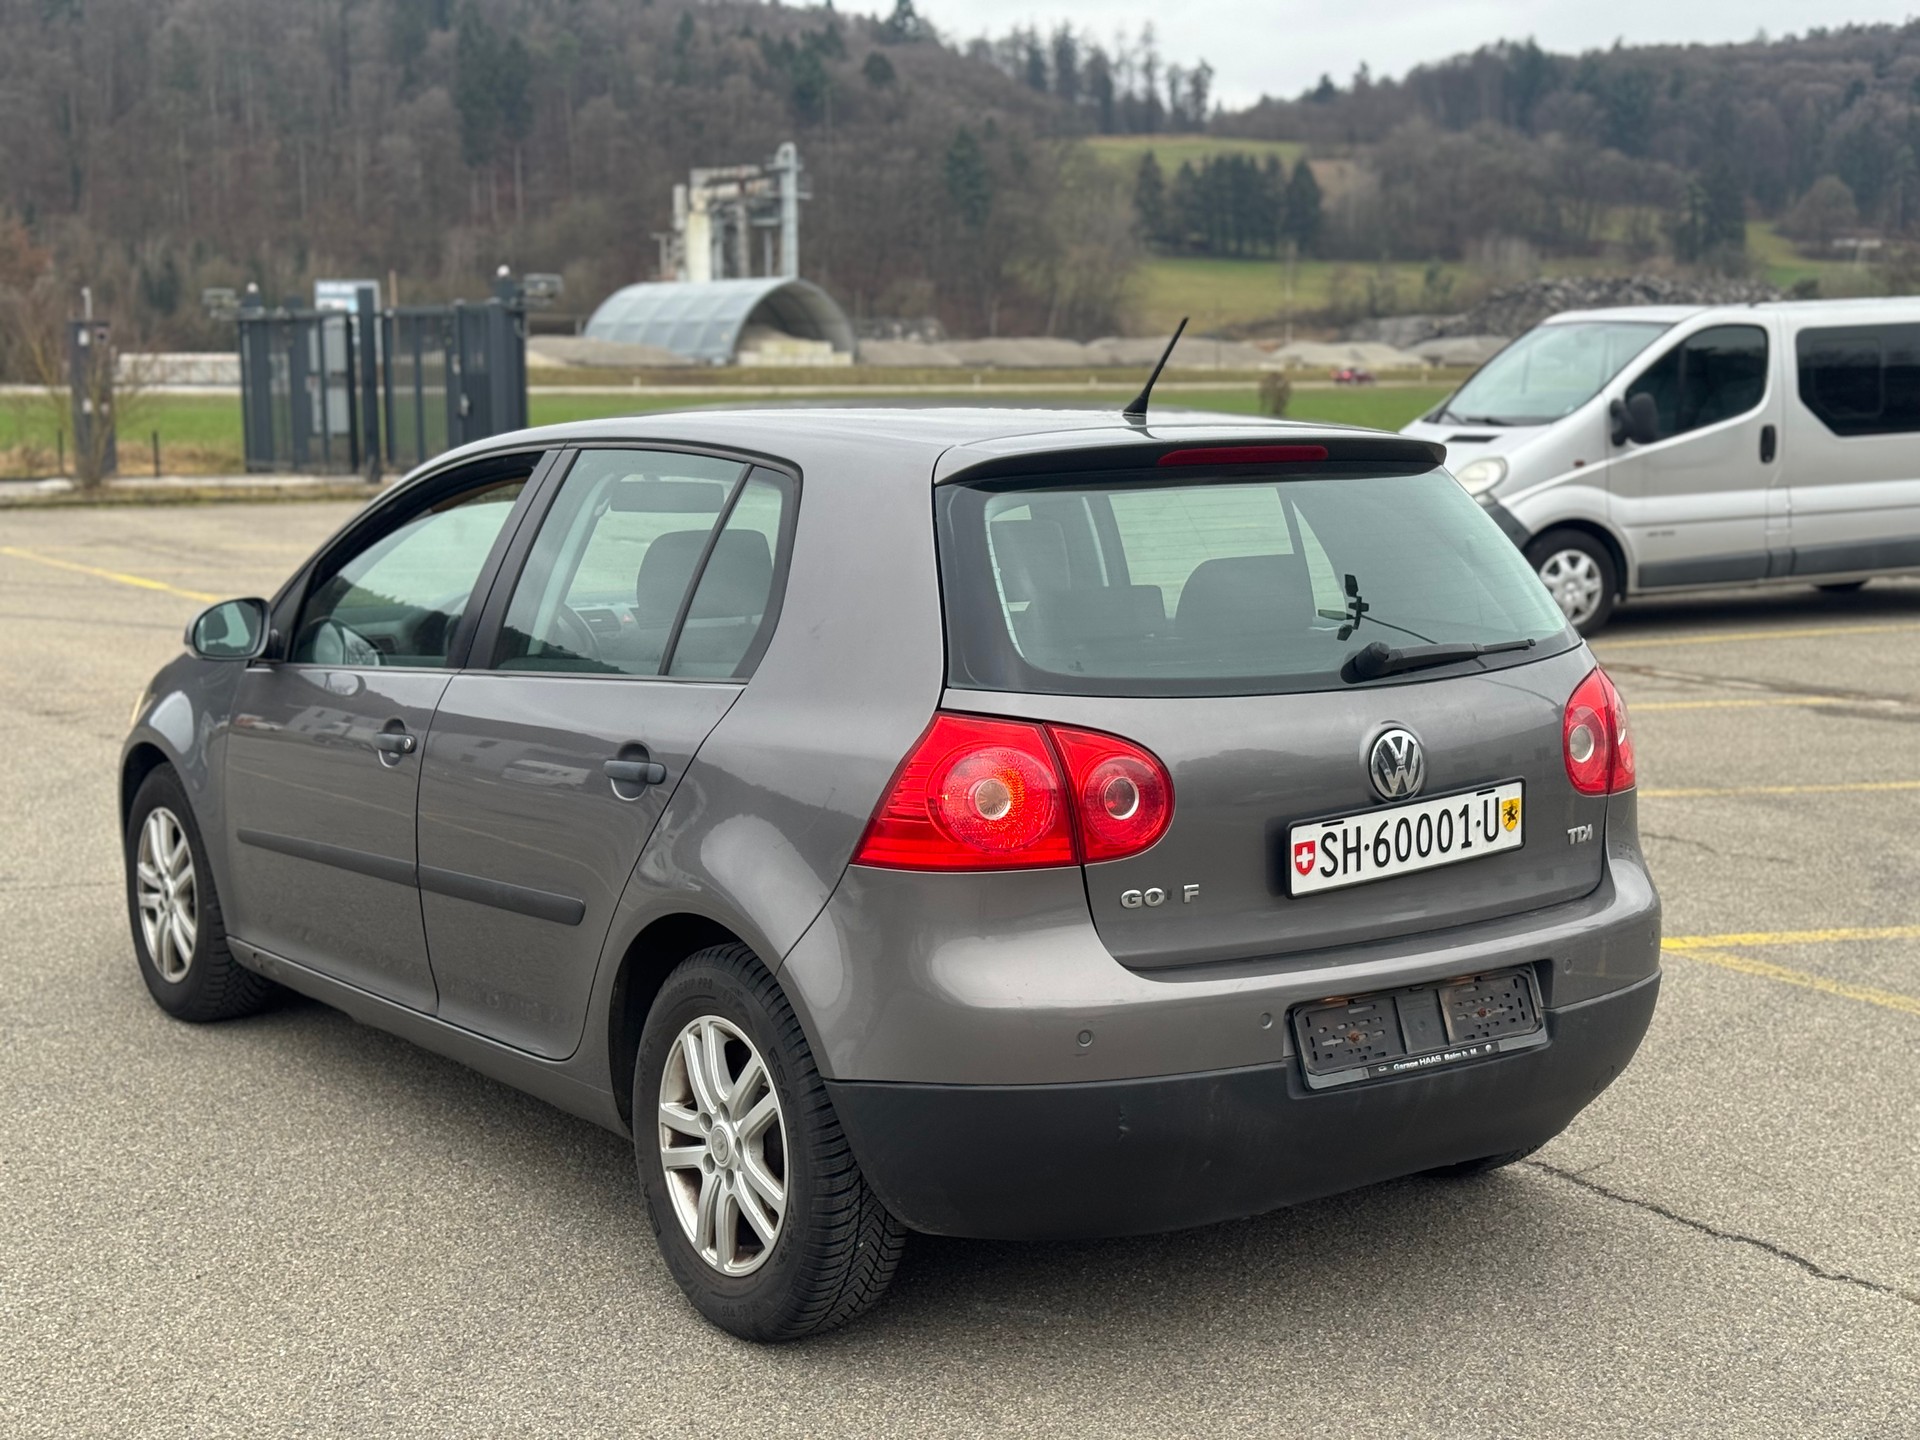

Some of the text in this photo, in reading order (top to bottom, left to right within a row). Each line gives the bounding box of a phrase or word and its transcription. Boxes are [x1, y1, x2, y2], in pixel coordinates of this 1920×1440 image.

[1371, 729, 1423, 797] VW
[1568, 824, 1592, 844] TDI
[1419, 1055, 1441, 1066] HAAS
